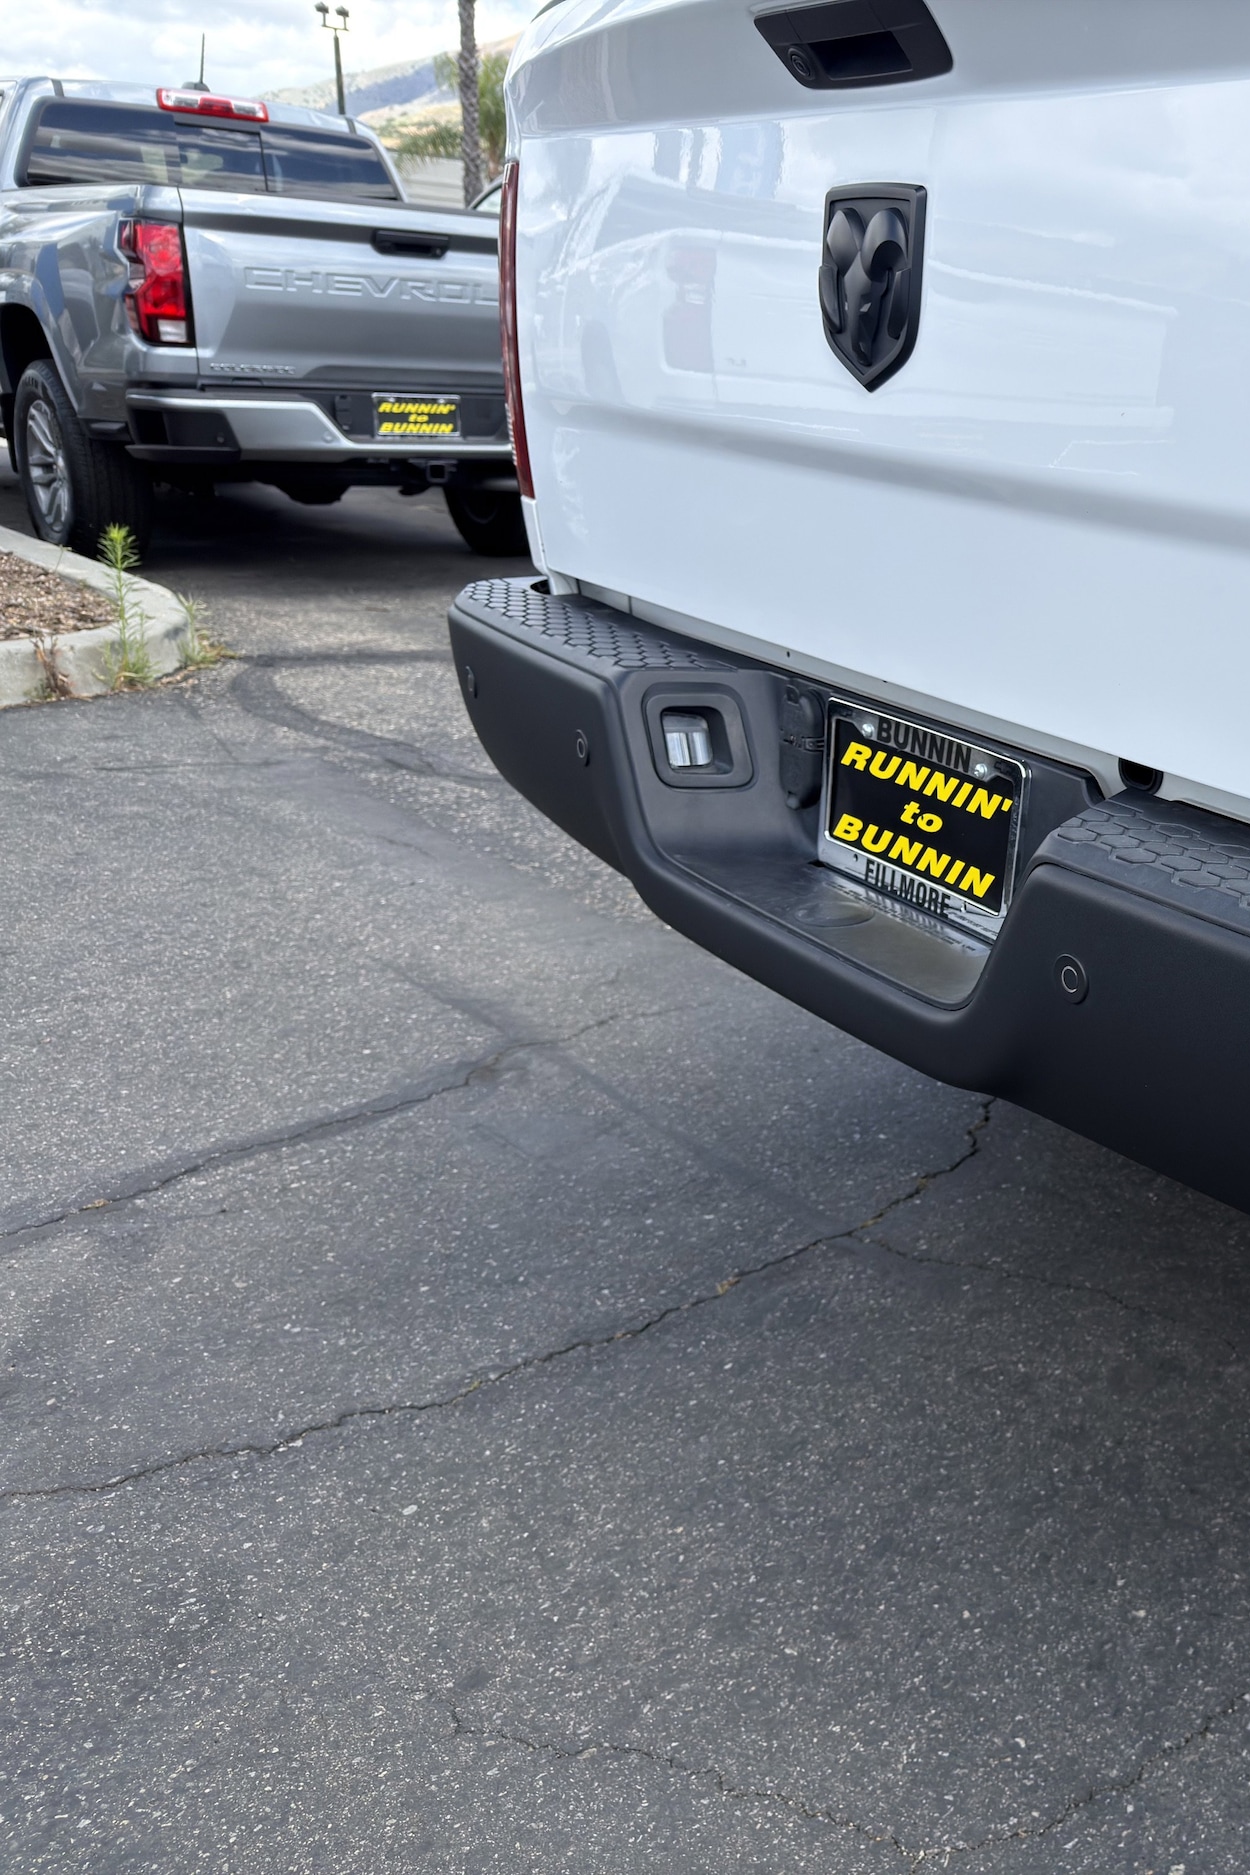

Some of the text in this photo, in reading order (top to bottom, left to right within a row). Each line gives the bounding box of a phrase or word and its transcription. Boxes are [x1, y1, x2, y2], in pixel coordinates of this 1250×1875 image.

[378, 402, 456, 414] RUNNIN'
[379, 422, 454, 433] BUNNIN
[408, 413, 429, 422] to
[877, 717, 971, 774] BUNNIN
[840, 741, 1013, 819] RUNNIN'
[900, 801, 943, 833] to
[833, 814, 995, 898] BUNNIN
[865, 859, 949, 918] FILLMORE
